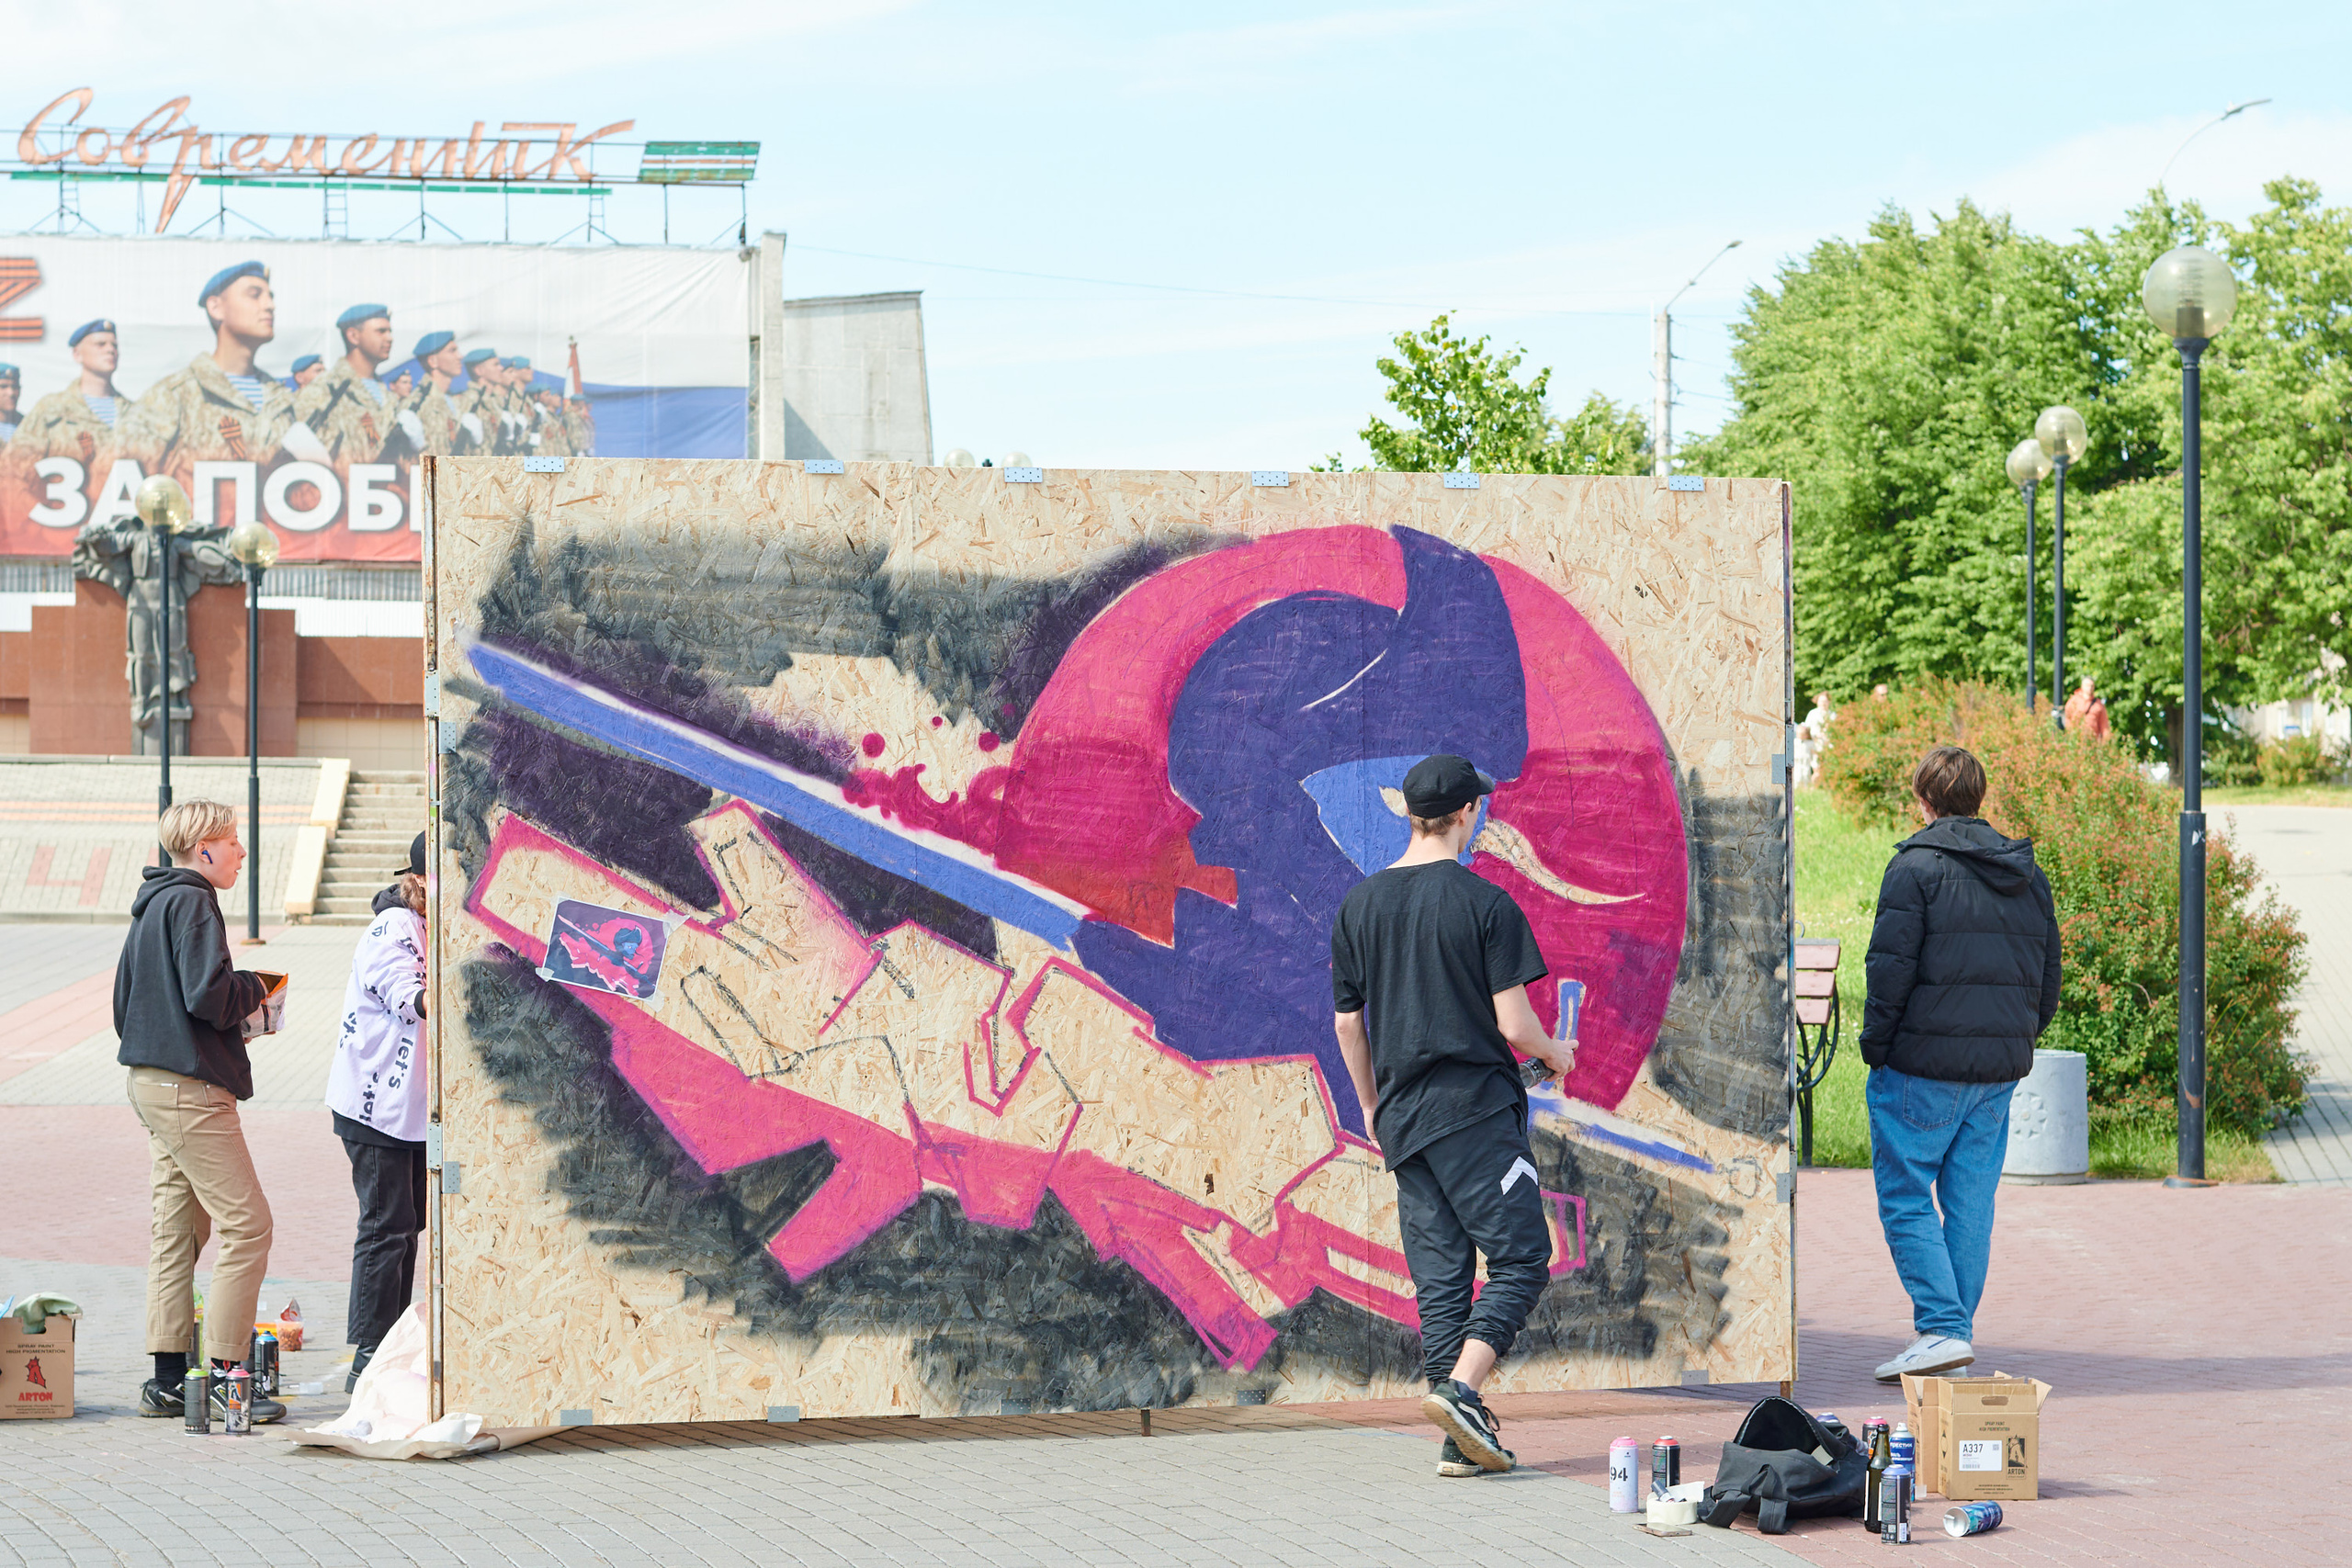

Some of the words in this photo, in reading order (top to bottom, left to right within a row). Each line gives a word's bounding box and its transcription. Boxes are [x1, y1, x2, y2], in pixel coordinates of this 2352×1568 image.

[17, 86, 635, 233] Современник
[28, 457, 147, 528] ЗА
[388, 1037, 413, 1089] let's
[18, 1392, 53, 1402] ARTON
[1962, 1443, 1984, 1453] A337
[1610, 1466, 1628, 1482] 94
